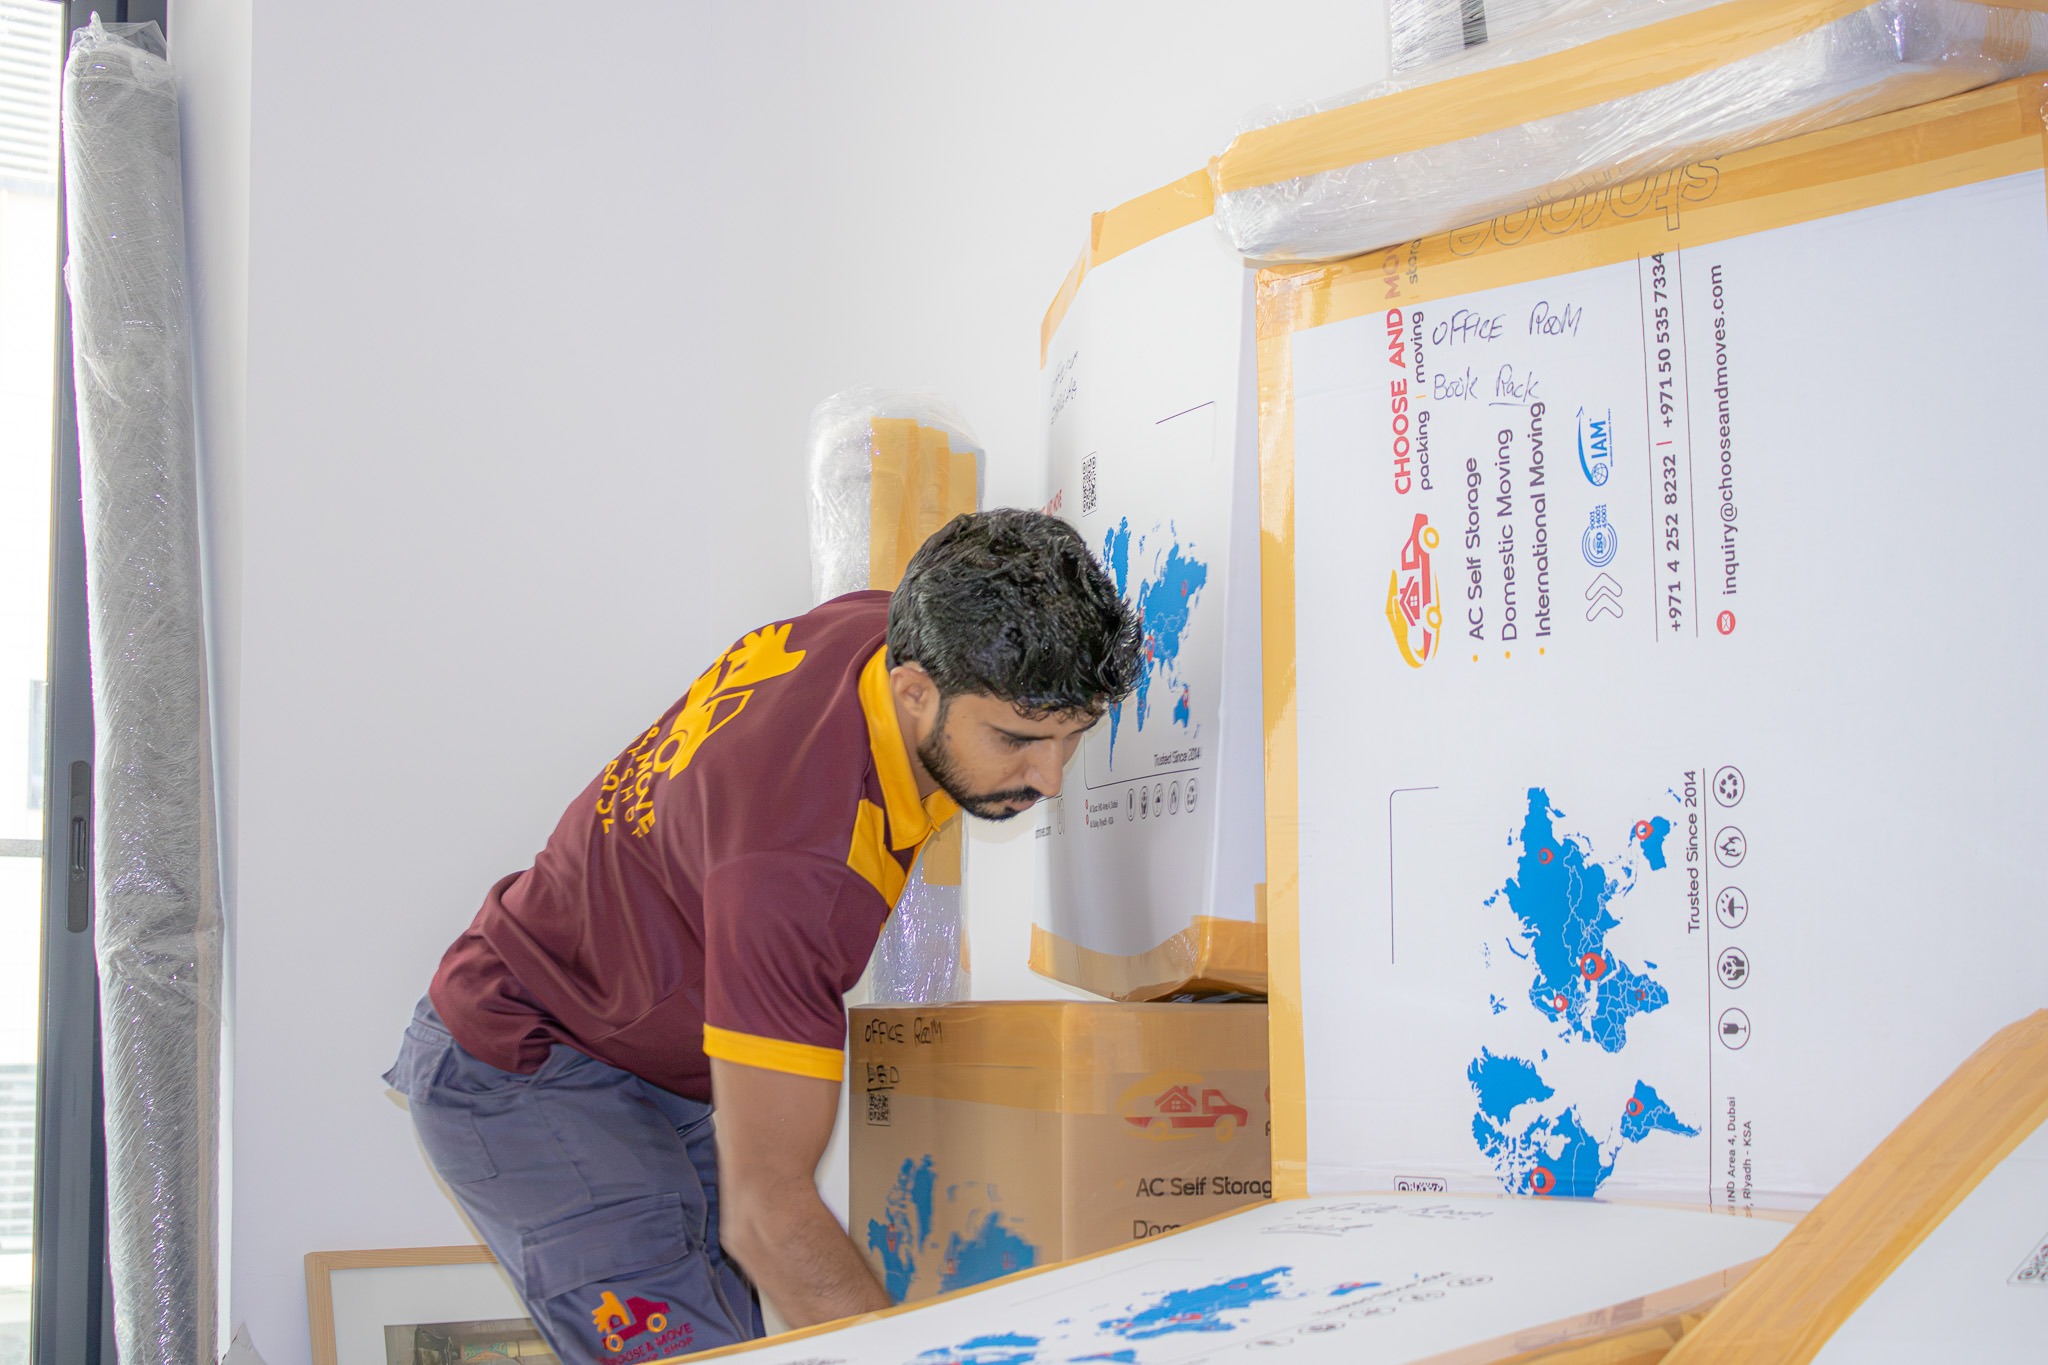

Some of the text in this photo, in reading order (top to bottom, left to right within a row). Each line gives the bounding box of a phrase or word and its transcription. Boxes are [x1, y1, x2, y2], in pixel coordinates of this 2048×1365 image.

[1384, 240, 1411, 495] CHOOSE AND MO
[1406, 238, 1433, 491] packing moving stora
[1433, 366, 1478, 400] Book
[1590, 420, 1608, 459] IAM
[1652, 251, 1682, 632] +971 4 252 8232 +971 50 535 7334
[1711, 264, 1739, 595] inquiry@chooseandmoves.com
[1495, 429, 1518, 641] Domestic Moving
[1526, 402, 1551, 637] International Moving
[1465, 457, 1485, 640] AC Self Storage
[1595, 532, 1603, 554] ISO
[1684, 770, 1700, 934] Trusted Since 2014
[1727, 1096, 1736, 1131] Dubai
[1743, 1120, 1752, 1147] KSA
[1727, 1149, 1736, 1178] Area
[1742, 1158, 1753, 1200] Riyadh
[1136, 1176, 1272, 1199] AC Self Storag
[1726, 1180, 1736, 1203] IND
[654, 1322, 694, 1347] MOVE
